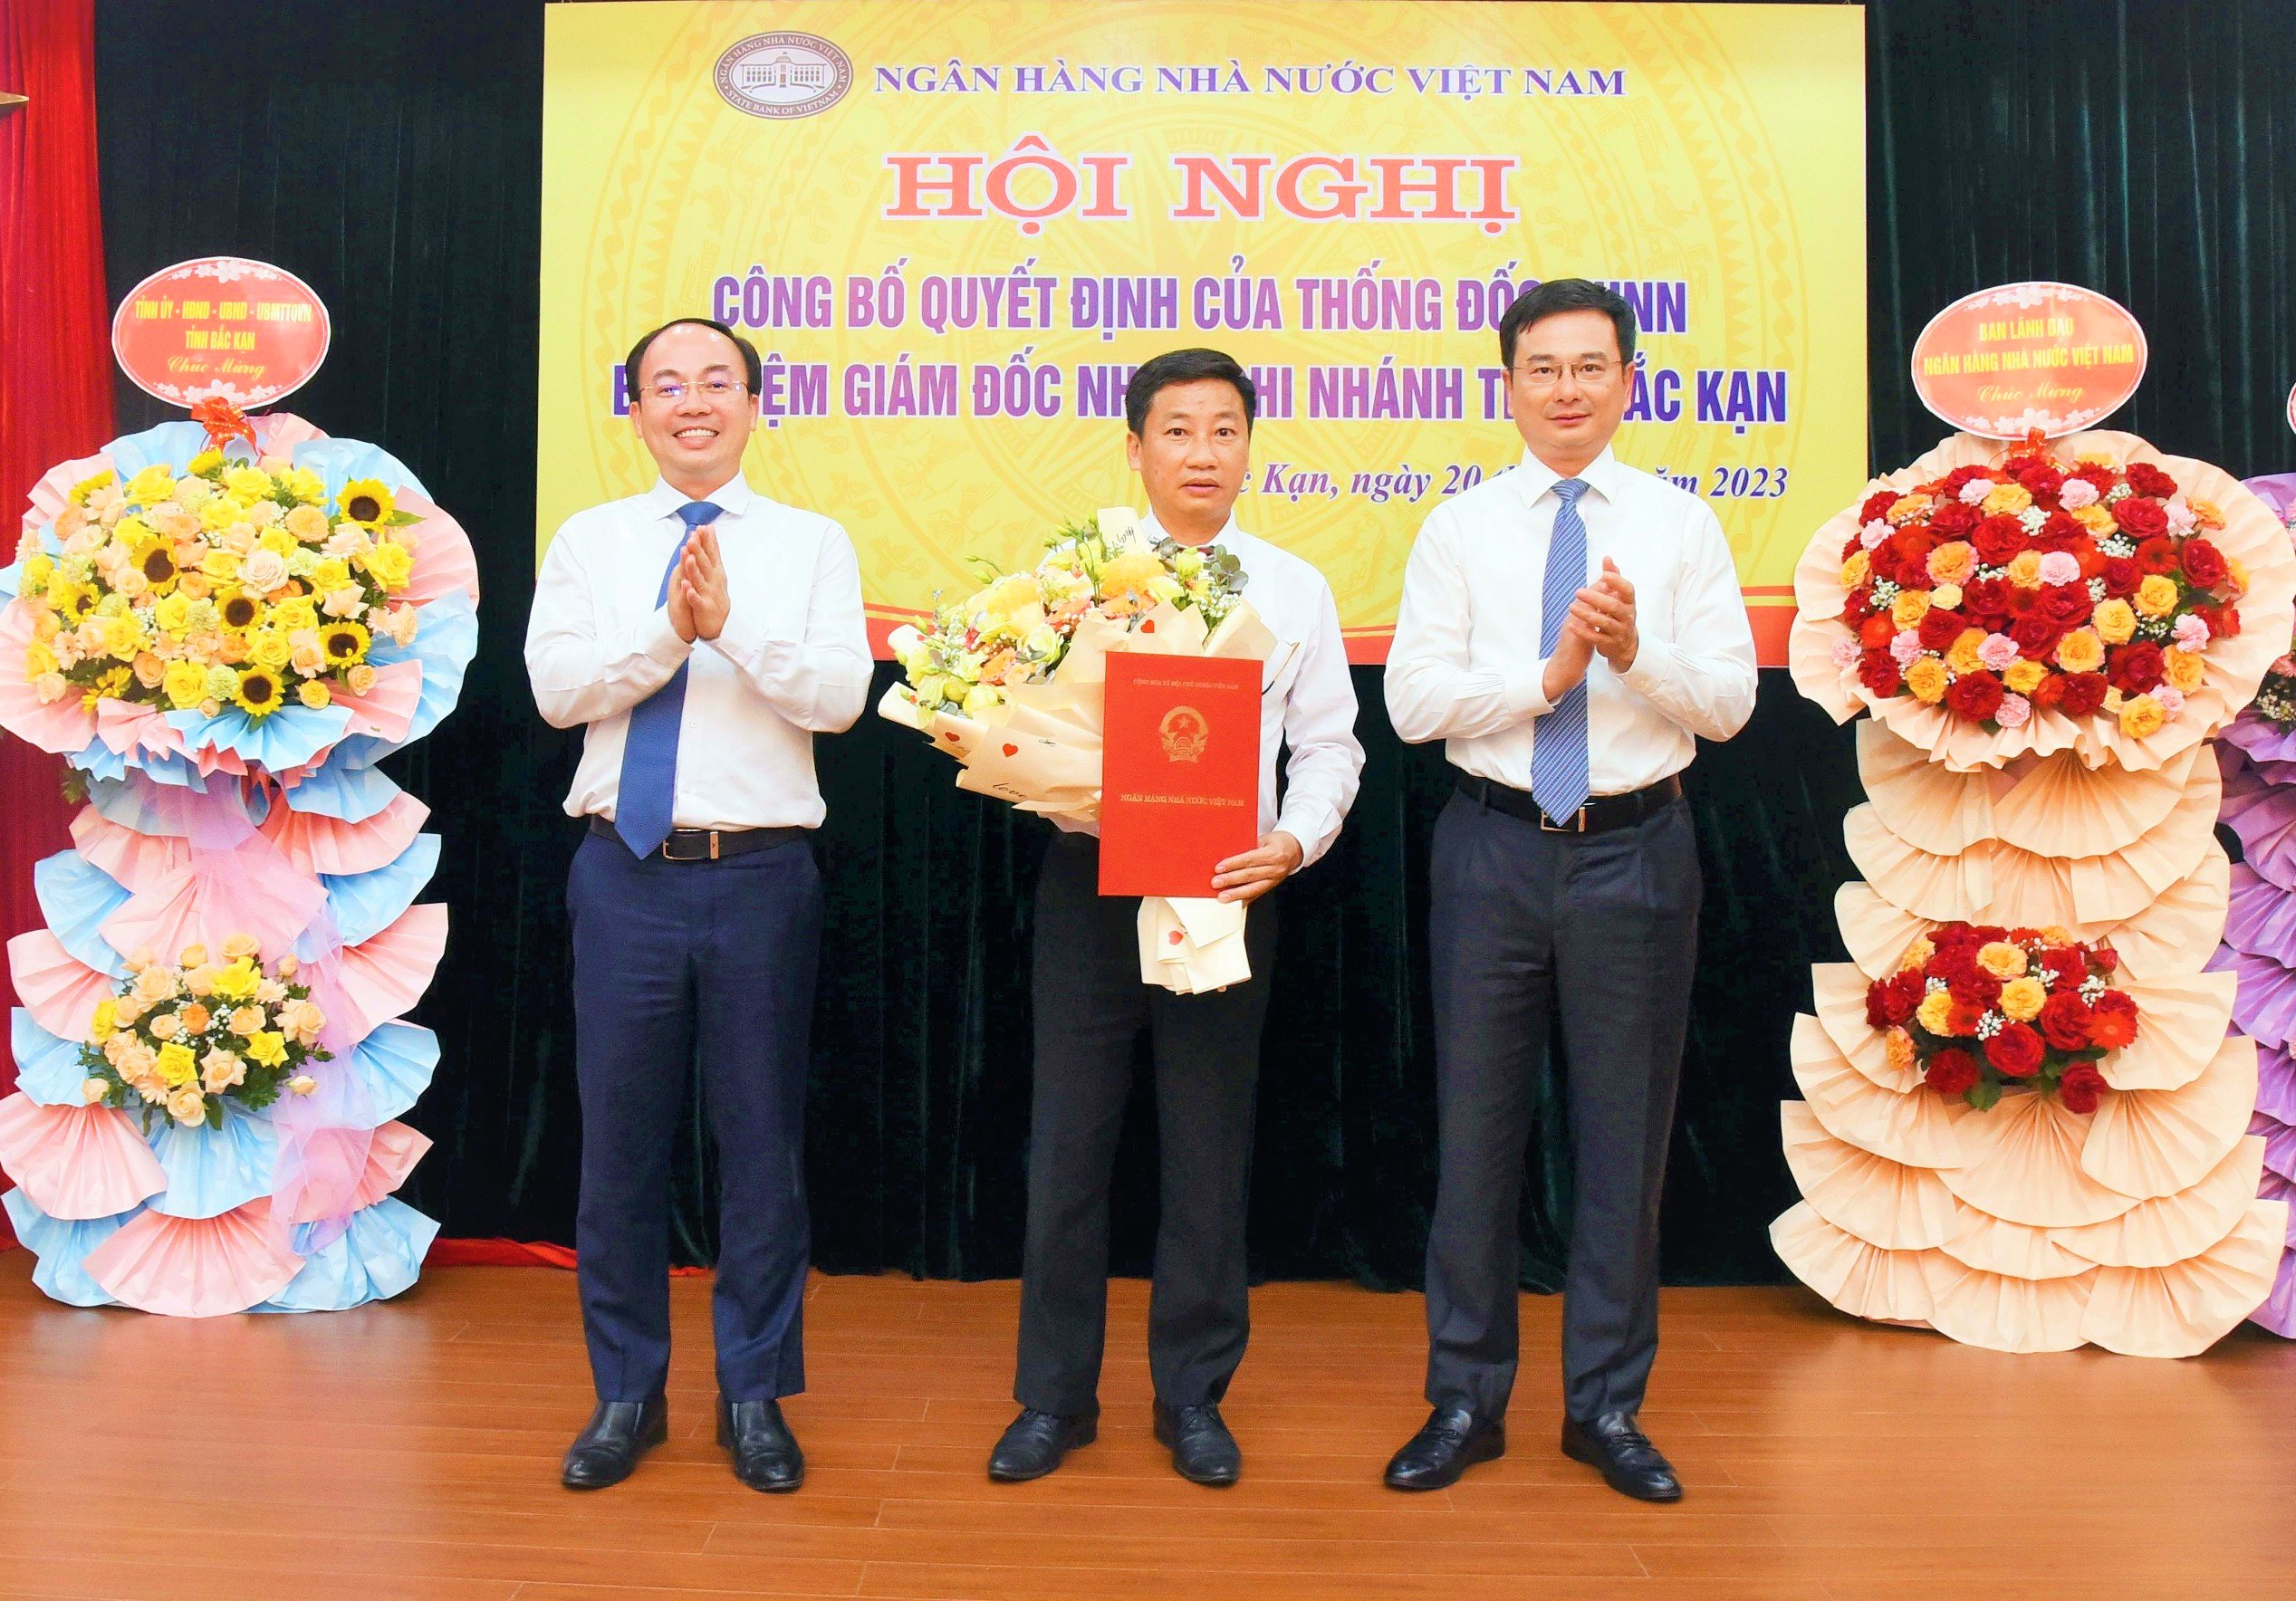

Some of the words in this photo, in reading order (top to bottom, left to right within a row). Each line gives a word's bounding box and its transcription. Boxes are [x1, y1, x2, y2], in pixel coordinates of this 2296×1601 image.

[763, 34, 785, 45] NHÀ
[836, 60, 849, 82] NAM
[874, 59, 998, 93] NGÂN
[1012, 57, 1143, 93] HÀNG
[1156, 58, 1252, 93] NHÀ
[1265, 62, 1395, 94] NƯỚC
[1407, 58, 1512, 101] VIỆT
[1523, 68, 1626, 96] NAM
[725, 90, 752, 110] STATE
[753, 103, 780, 115] BANK
[782, 106, 795, 115] OF
[797, 91, 839, 114] VIETNAM
[886, 135, 1129, 235] HỘI
[1174, 157, 1516, 235] NGHỊ
[713, 265, 832, 329] CÔNG
[847, 257, 908, 329] BỐ
[921, 257, 1057, 334] QUYẾT
[1071, 275, 1177, 341] ĐỊNH
[1193, 254, 1282, 330] CỦA
[1296, 259, 1442, 331] THỐNG
[1455, 261, 1541, 331] ĐỐ
[186, 324, 208, 350] TỈNH
[234, 331, 255, 354] KẠN
[1979, 321, 2006, 341] BAN
[2010, 316, 2043, 340] LÃNH
[168, 356, 209, 373] Chúc
[1924, 351, 1960, 377] NGÂN
[1963, 350, 1999, 374] HÀNG
[2002, 346, 2030, 371] NHÀ
[2071, 342, 2099, 370] VIỆT
[2102, 343, 2134, 365] NAM
[844, 353, 957, 418] GIÁM
[972, 346, 1062, 417] ĐỐC
[1248, 367, 1292, 418] HI
[1310, 355, 1462, 420] NHÁNH
[1622, 351, 1680, 422] ẮC
[1698, 370, 1786, 435] KẠN
[1977, 385, 2023, 403] Chúc
[1263, 463, 1339, 503] Kạn,
[1350, 464, 1432, 503] ngày
[1441, 465, 1482, 494] 20
[1710, 467, 1788, 497] 2023
